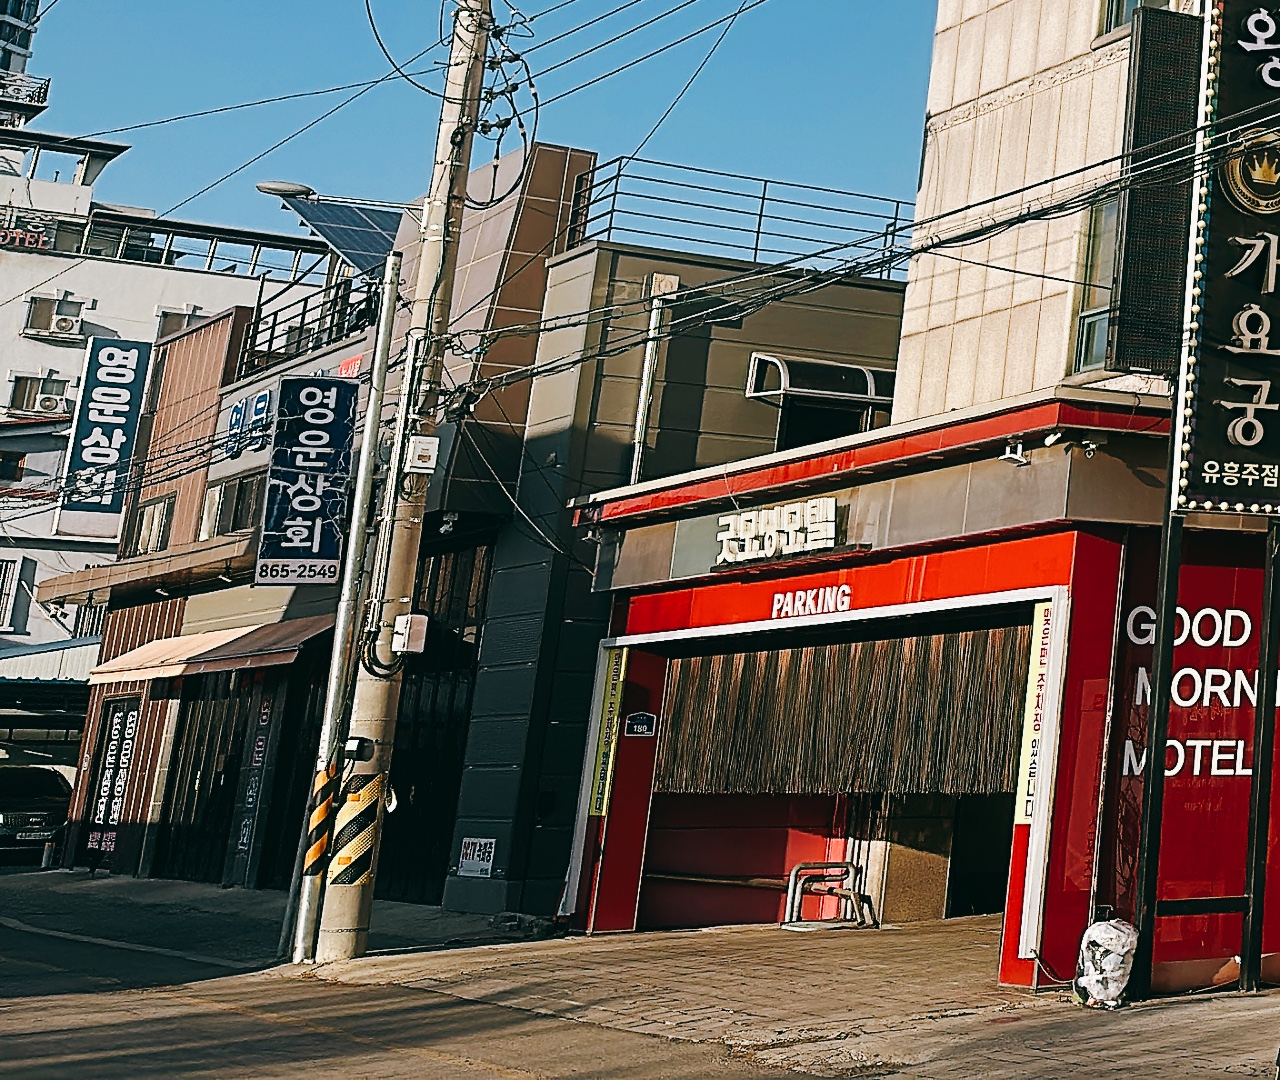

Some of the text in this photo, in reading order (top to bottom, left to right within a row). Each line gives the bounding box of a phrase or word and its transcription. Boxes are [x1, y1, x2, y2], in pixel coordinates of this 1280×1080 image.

[71, 346, 139, 505] 영운상회
[280, 386, 337, 553] 영운상회
[1201, 459, 1279, 488] 유흥주점
[258, 564, 337, 579] 865-2549
[771, 584, 851, 618] PARKING
[1126, 605, 1252, 647] GOOD
[1122, 739, 1253, 777] MOTEL
